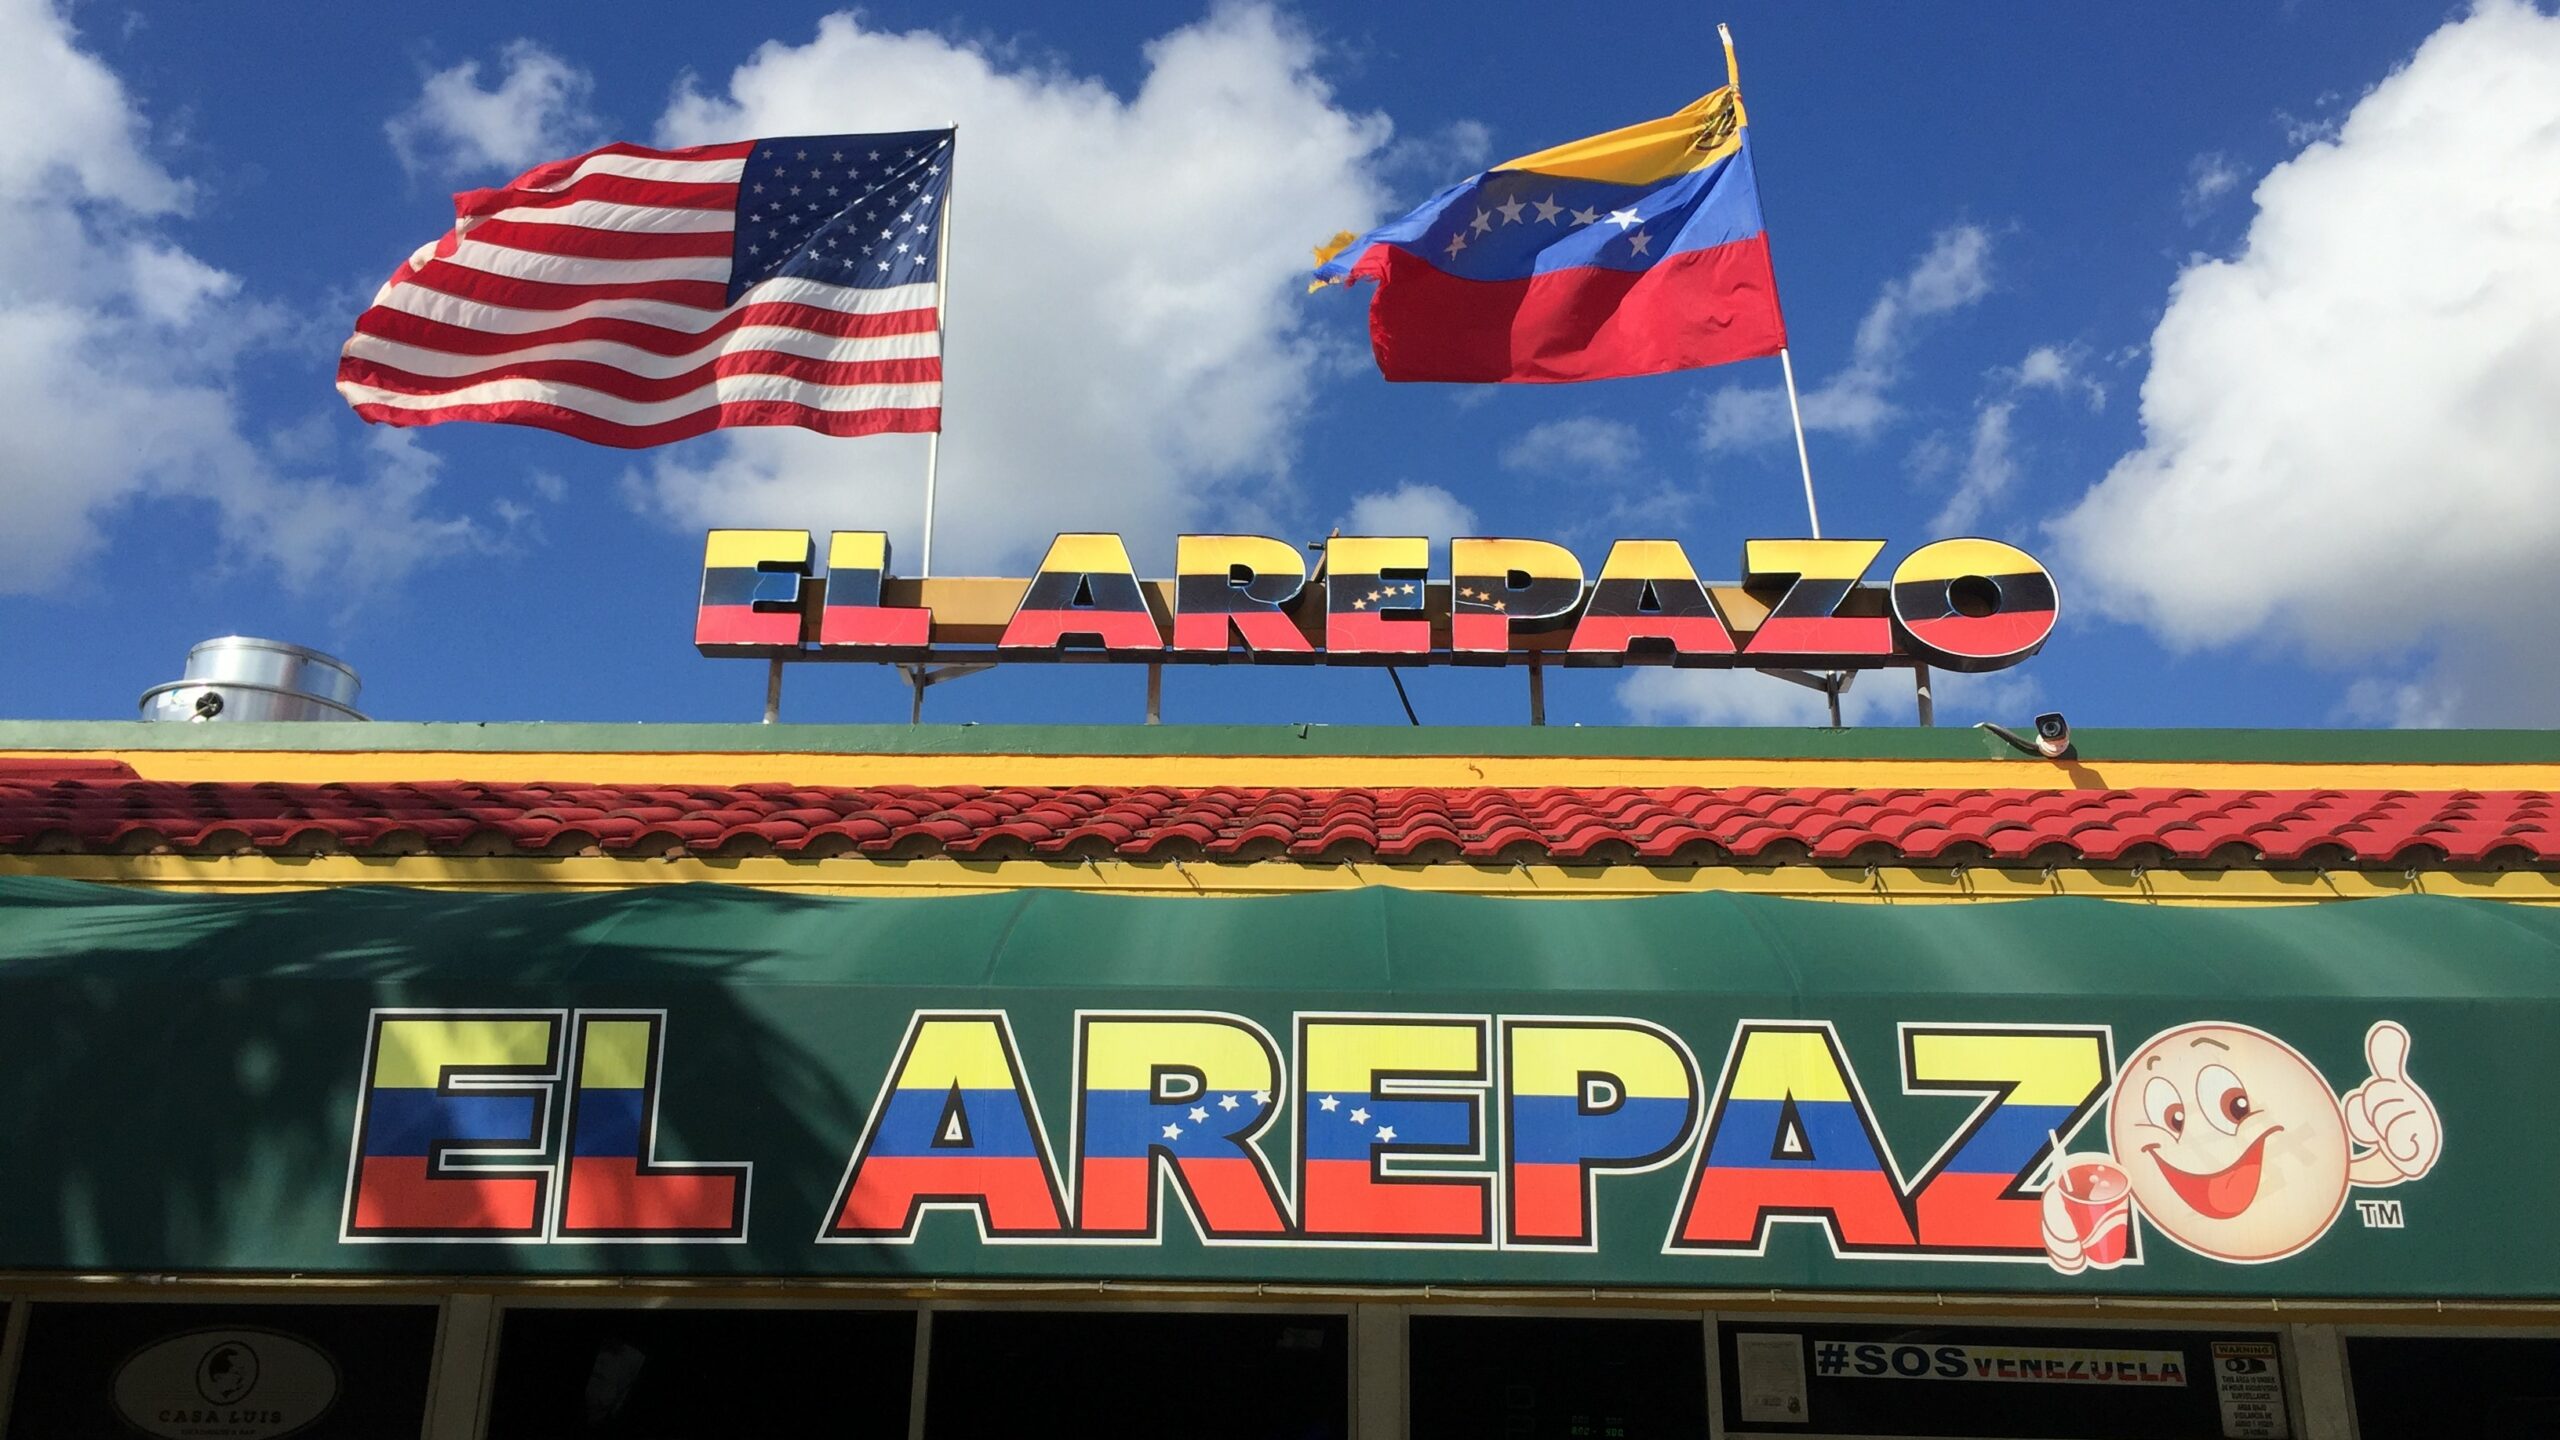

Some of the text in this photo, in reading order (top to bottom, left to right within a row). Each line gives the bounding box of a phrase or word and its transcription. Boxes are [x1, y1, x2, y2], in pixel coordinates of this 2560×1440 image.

[694, 529, 2060, 671] EL AREPAZO
[338, 1008, 752, 1244] EL
[2356, 1200, 2404, 1228] TM
[2218, 1345, 2269, 1353] WARNING
[158, 1410, 281, 1424] CASA LUIS
